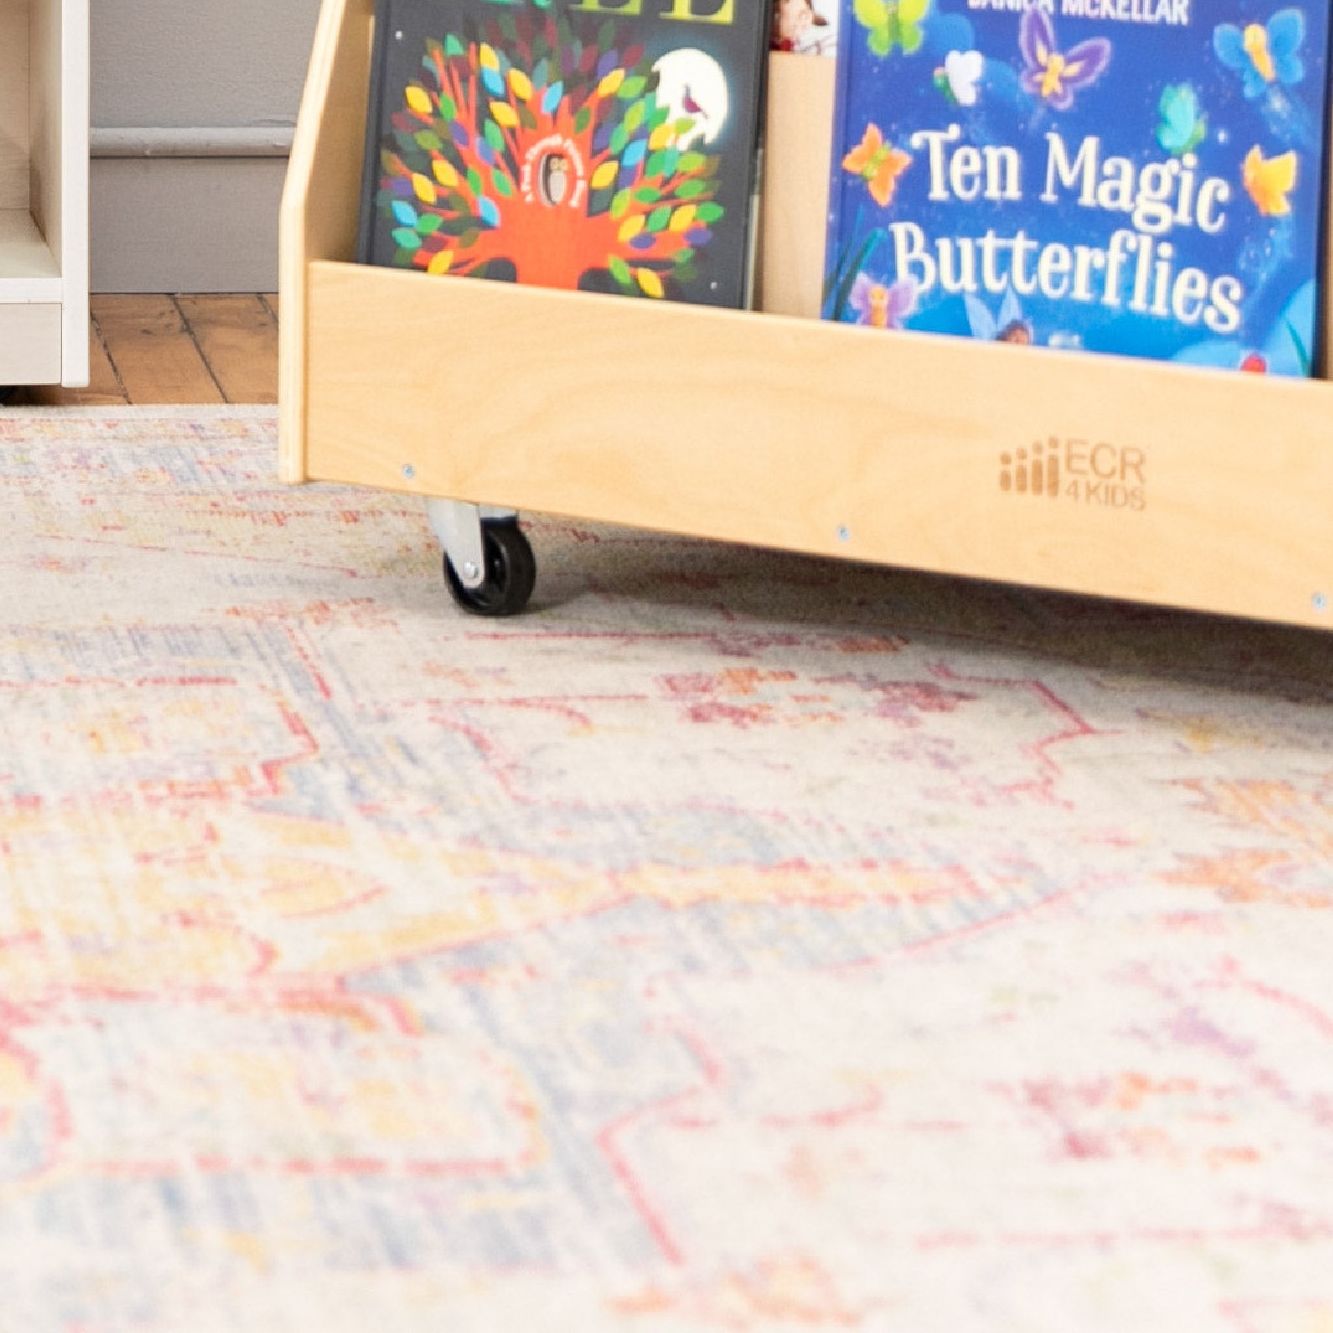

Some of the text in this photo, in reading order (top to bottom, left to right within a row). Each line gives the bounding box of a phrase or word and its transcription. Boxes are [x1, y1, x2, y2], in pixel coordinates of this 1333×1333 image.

[910, 123, 1230, 233] Ten Magic
[889, 221, 1245, 333] Butterflies
[1064, 438, 1146, 483] ECR
